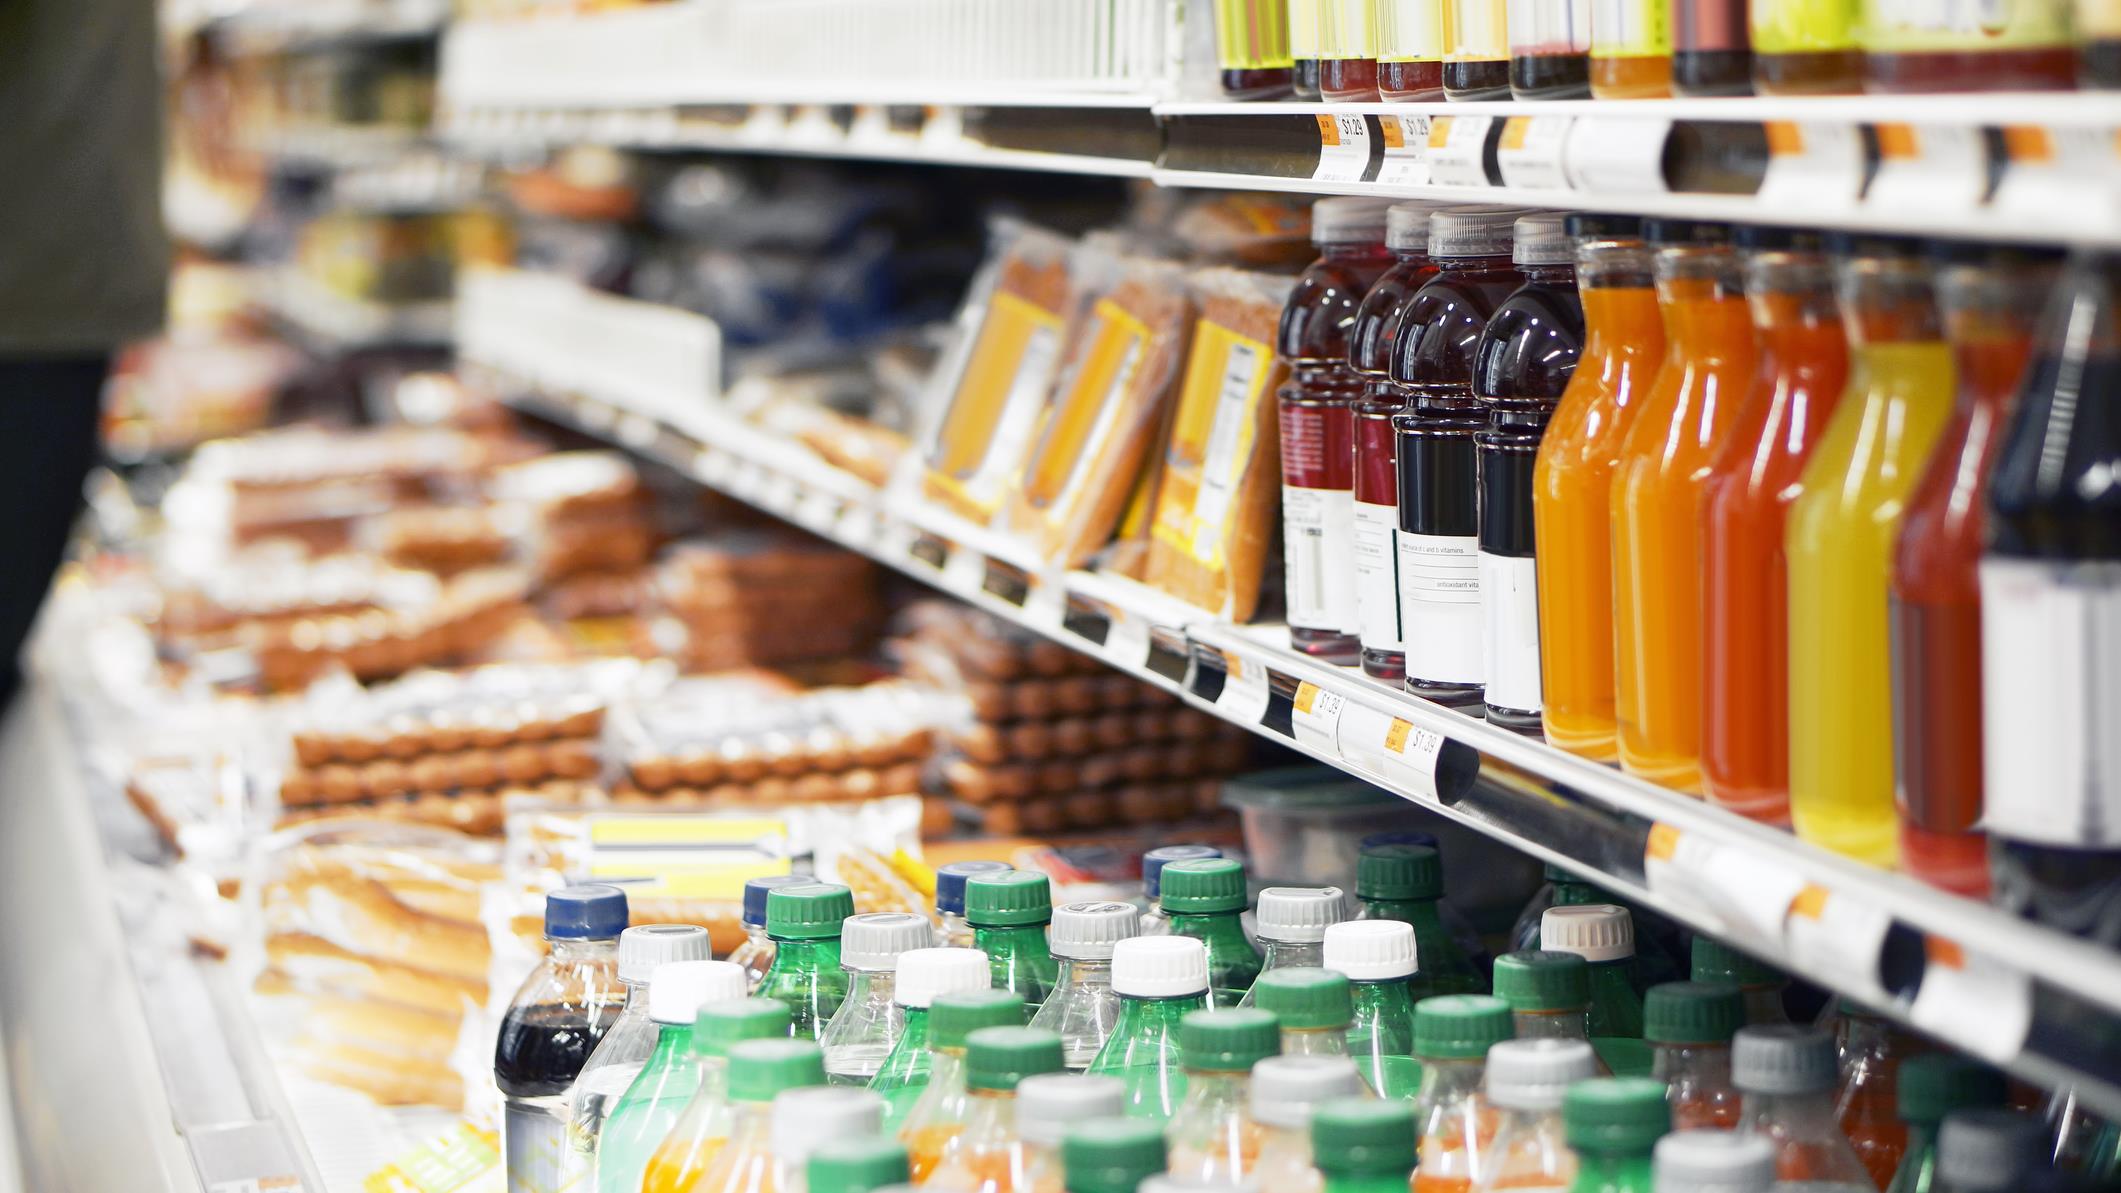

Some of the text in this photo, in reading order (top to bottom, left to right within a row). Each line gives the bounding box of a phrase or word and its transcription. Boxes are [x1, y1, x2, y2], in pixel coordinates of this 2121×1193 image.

[1342, 118, 1364, 136] $1.29
[1406, 118, 1428, 136] $1.29
[1440, 546, 1464, 554] vitamins
[1319, 692, 1340, 714] $1.39
[1413, 730, 1436, 752] $1.39
